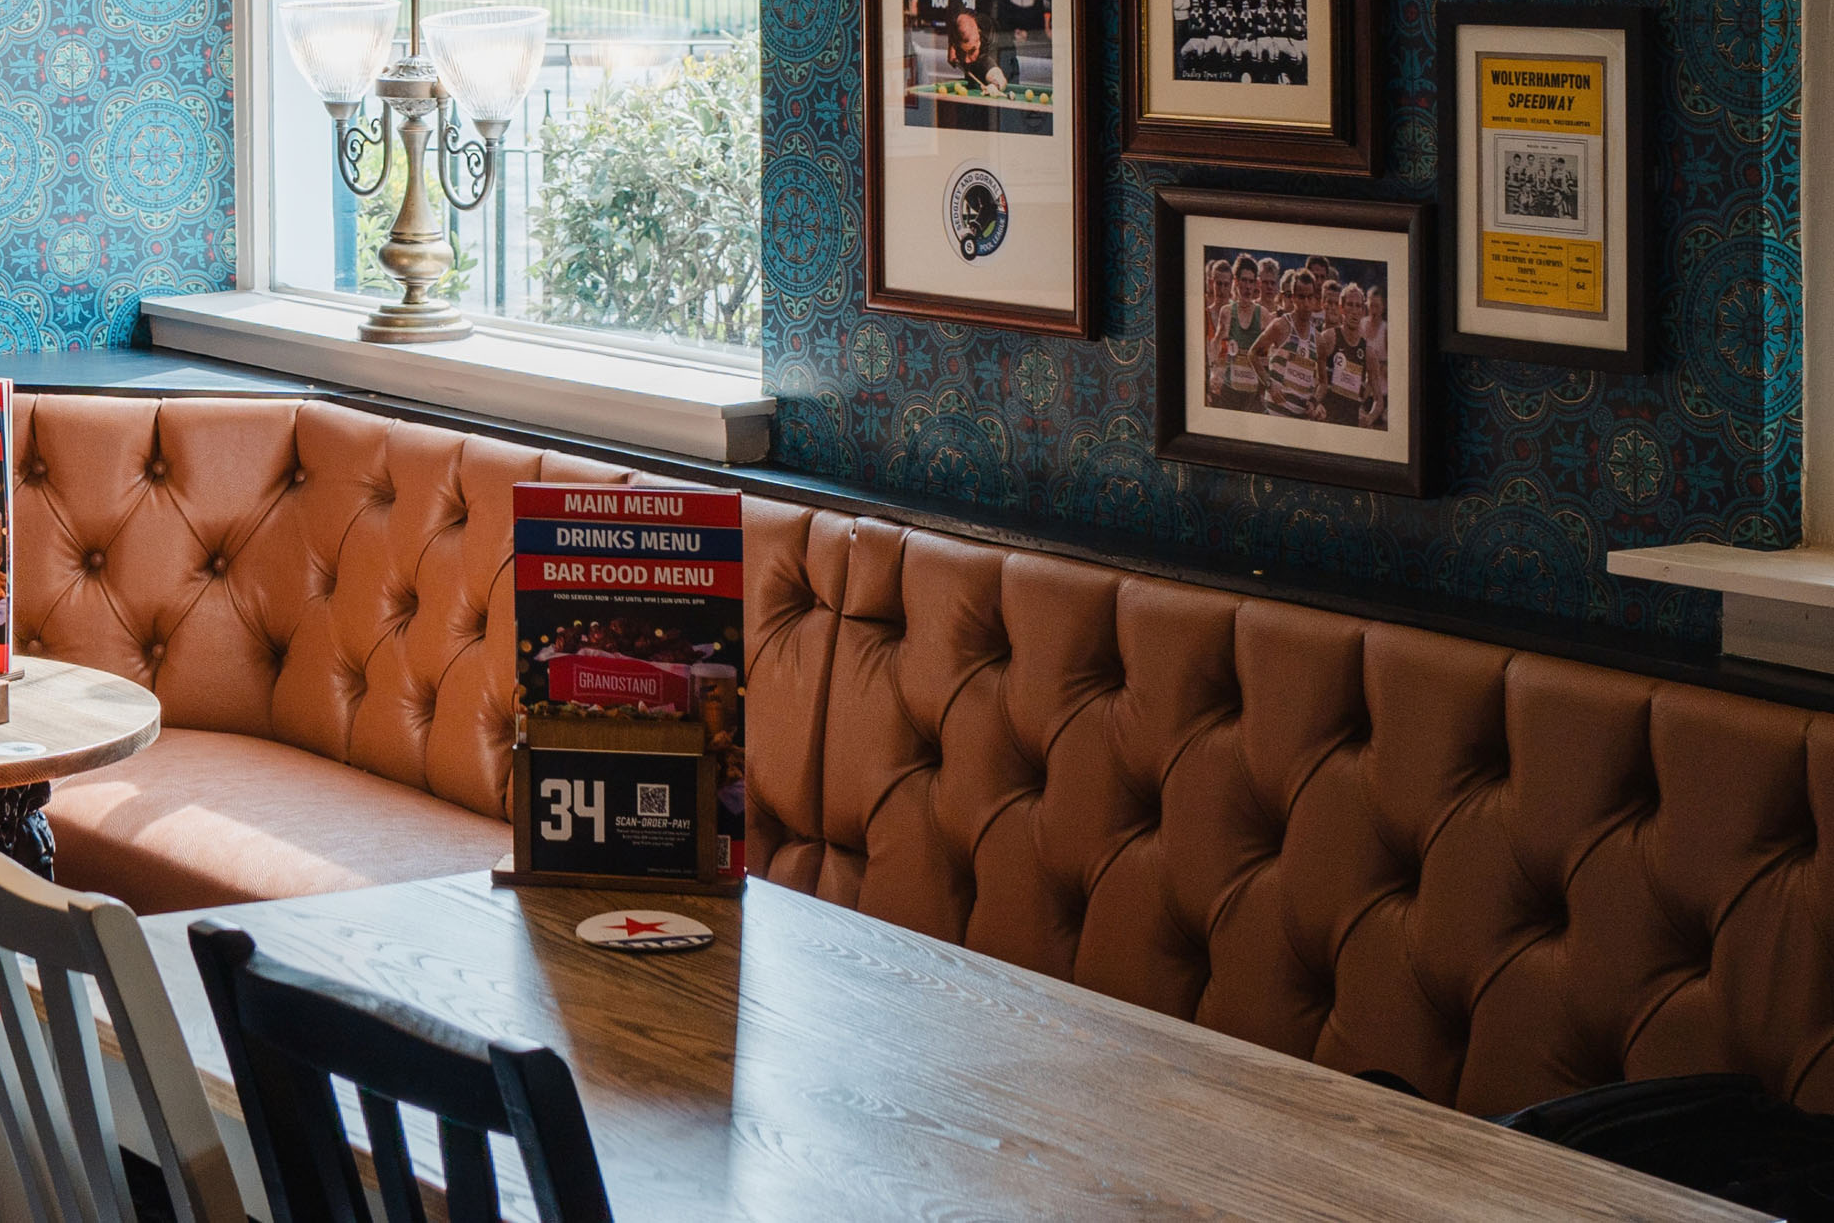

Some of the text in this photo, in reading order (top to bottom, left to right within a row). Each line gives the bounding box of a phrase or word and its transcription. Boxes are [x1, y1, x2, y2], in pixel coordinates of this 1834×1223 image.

[1491, 69, 1591, 90] WOLVERHAMPTON
[1507, 92, 1576, 112] SPEEDWAY
[960, 175, 974, 189] AND
[966, 242, 973, 252] 8
[564, 493, 684, 516] MAIN MENU
[556, 527, 701, 552] DRINKS MENU
[543, 562, 715, 587] BAR FOOD MENU
[578, 670, 657, 695] GRANDSTAND
[540, 778, 605, 843] 34
[615, 816, 691, 830] SCAN-ORDER-PAY!
